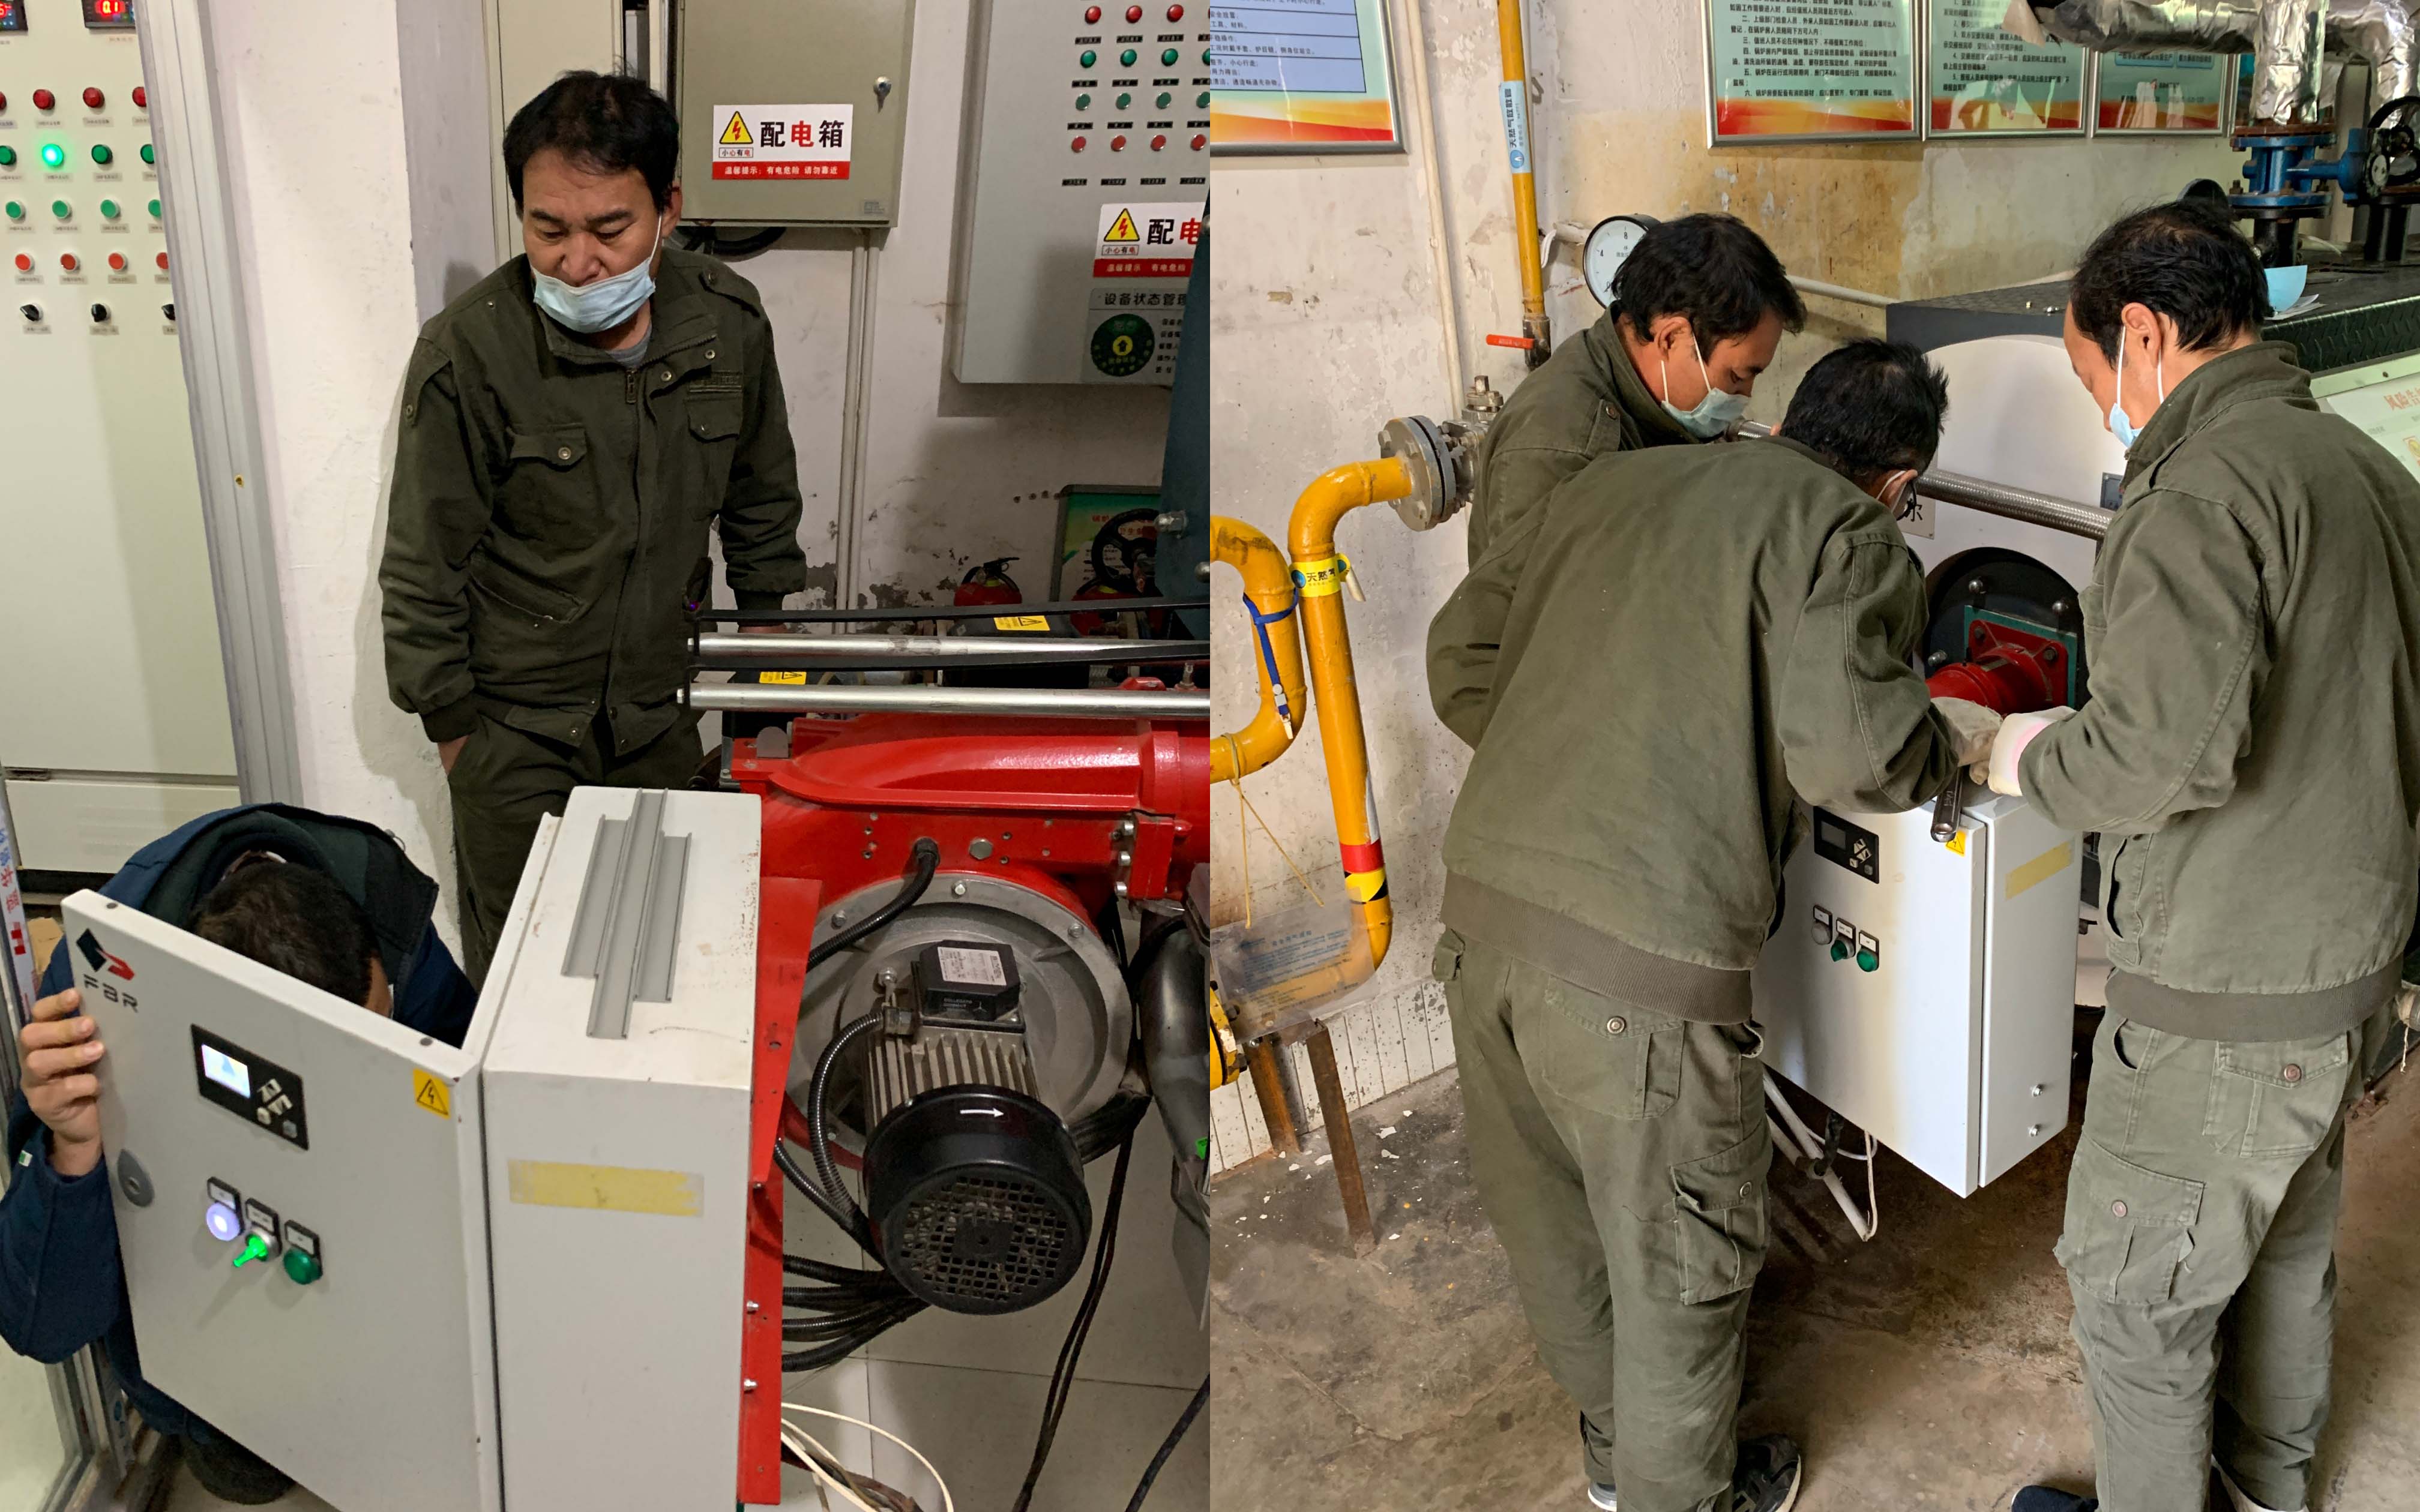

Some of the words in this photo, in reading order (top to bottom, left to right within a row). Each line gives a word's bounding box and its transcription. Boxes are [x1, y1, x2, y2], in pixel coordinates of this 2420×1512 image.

[1504, 88, 1517, 148] 天然气放散管
[760, 120, 844, 148] 配电箱
[766, 166, 800, 175] 有电危险
[804, 166, 838, 175] 请勿靠近
[1147, 218, 1202, 245] 配电
[1105, 246, 1136, 254] 小心有电
[1306, 568, 1335, 582] 天然气
[83, 973, 139, 1013] FBR
